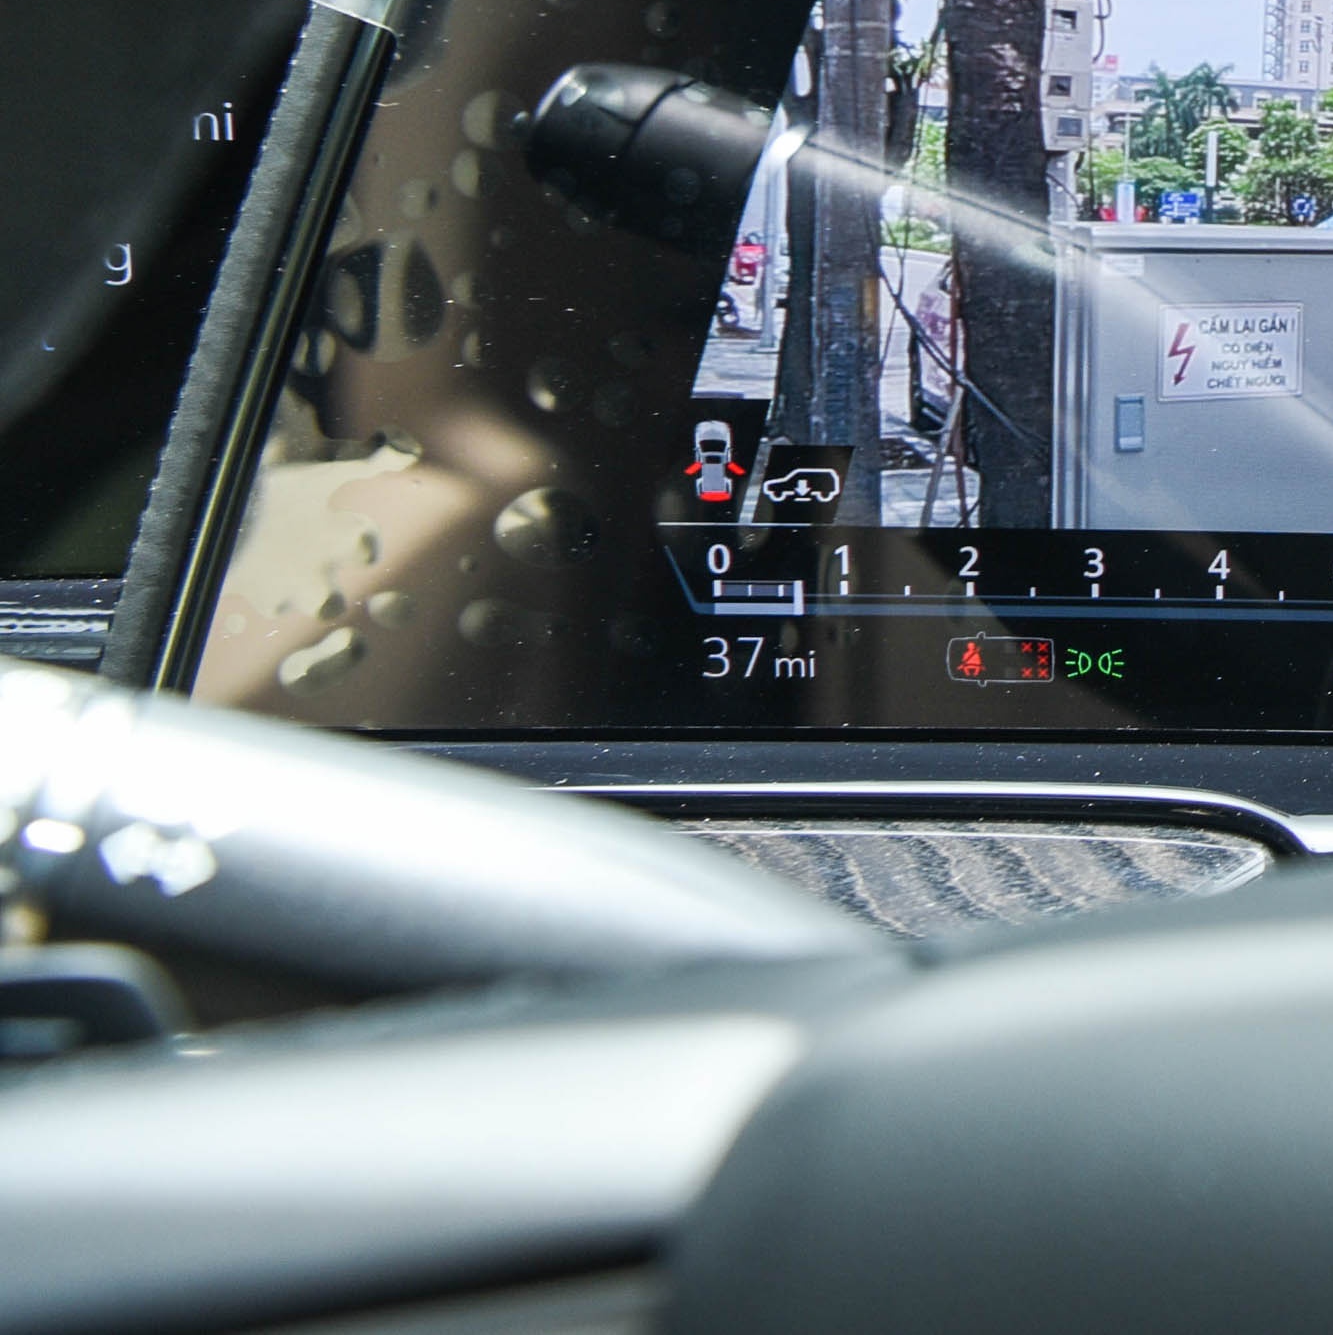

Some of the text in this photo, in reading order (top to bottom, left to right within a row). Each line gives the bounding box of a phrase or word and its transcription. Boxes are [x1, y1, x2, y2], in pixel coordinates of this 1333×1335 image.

[708, 544, 731, 574] 0
[834, 545, 851, 574] 1
[959, 547, 980, 576] 2
[1083, 548, 1105, 578] 3
[1208, 550, 1231, 579] 4
[702, 637, 817, 679] 37 mi
